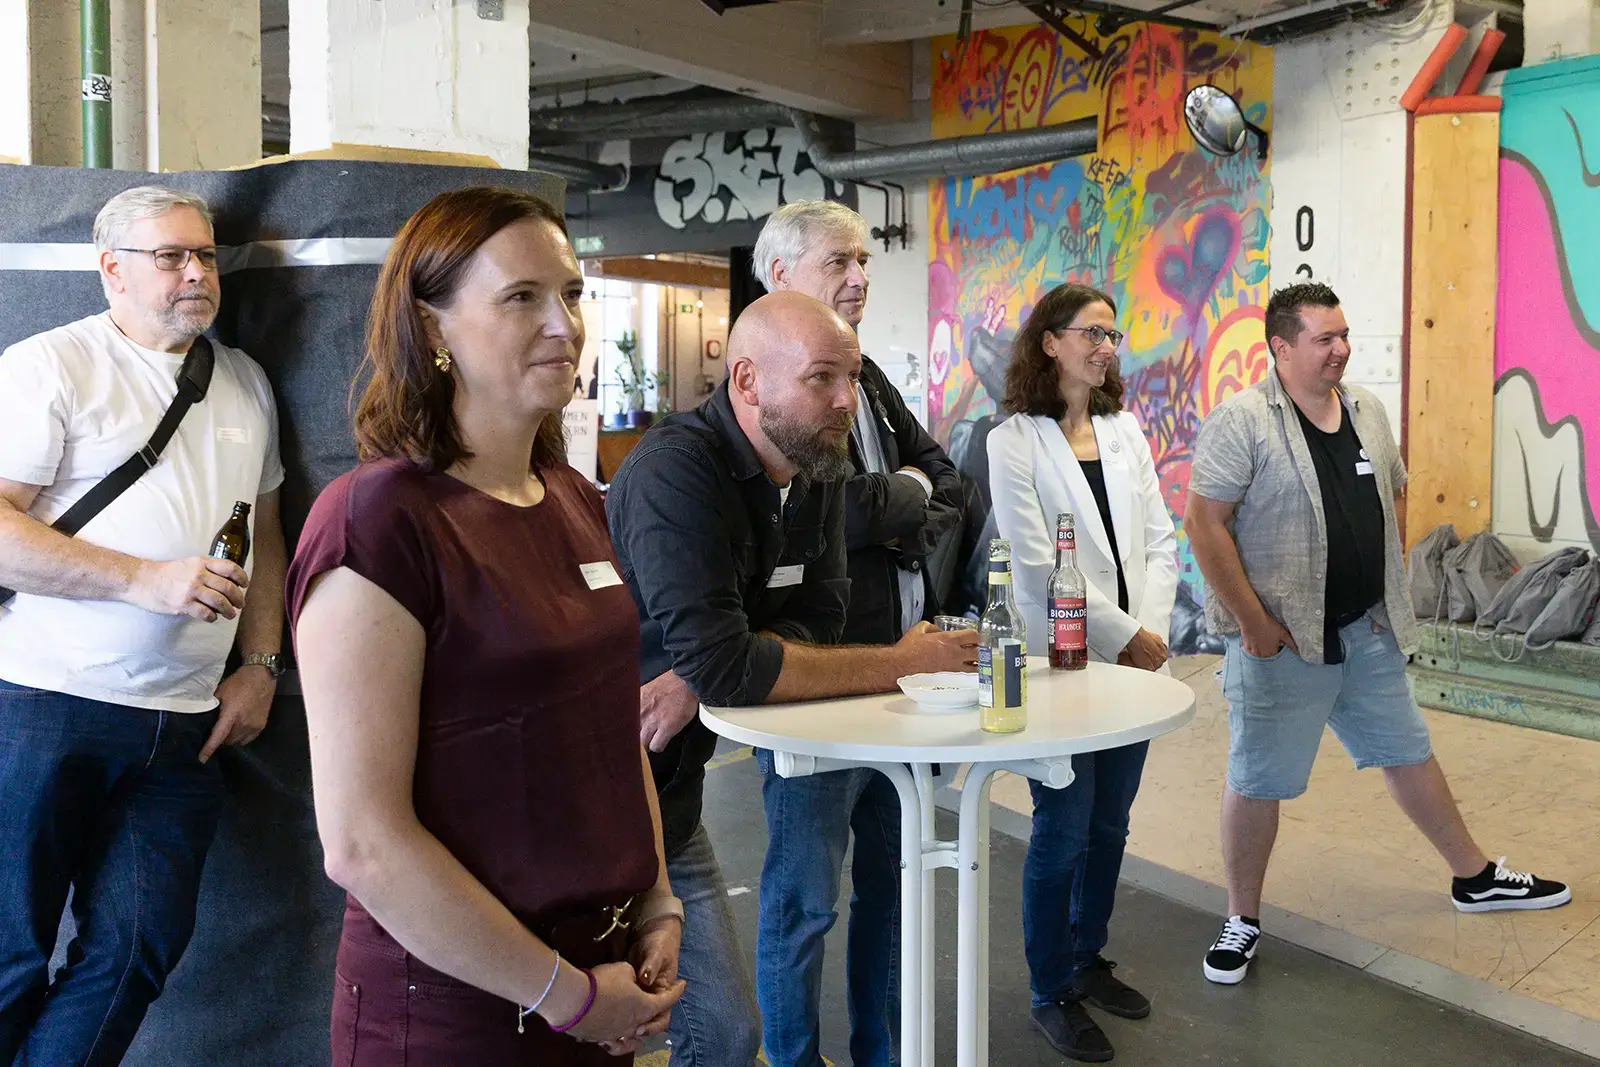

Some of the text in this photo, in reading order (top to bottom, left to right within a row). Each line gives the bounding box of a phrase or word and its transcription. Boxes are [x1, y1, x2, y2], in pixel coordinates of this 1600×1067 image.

[1086, 156, 1126, 195] KEEP
[1058, 531, 1074, 539] BIO
[1050, 608, 1087, 619] BIONADE
